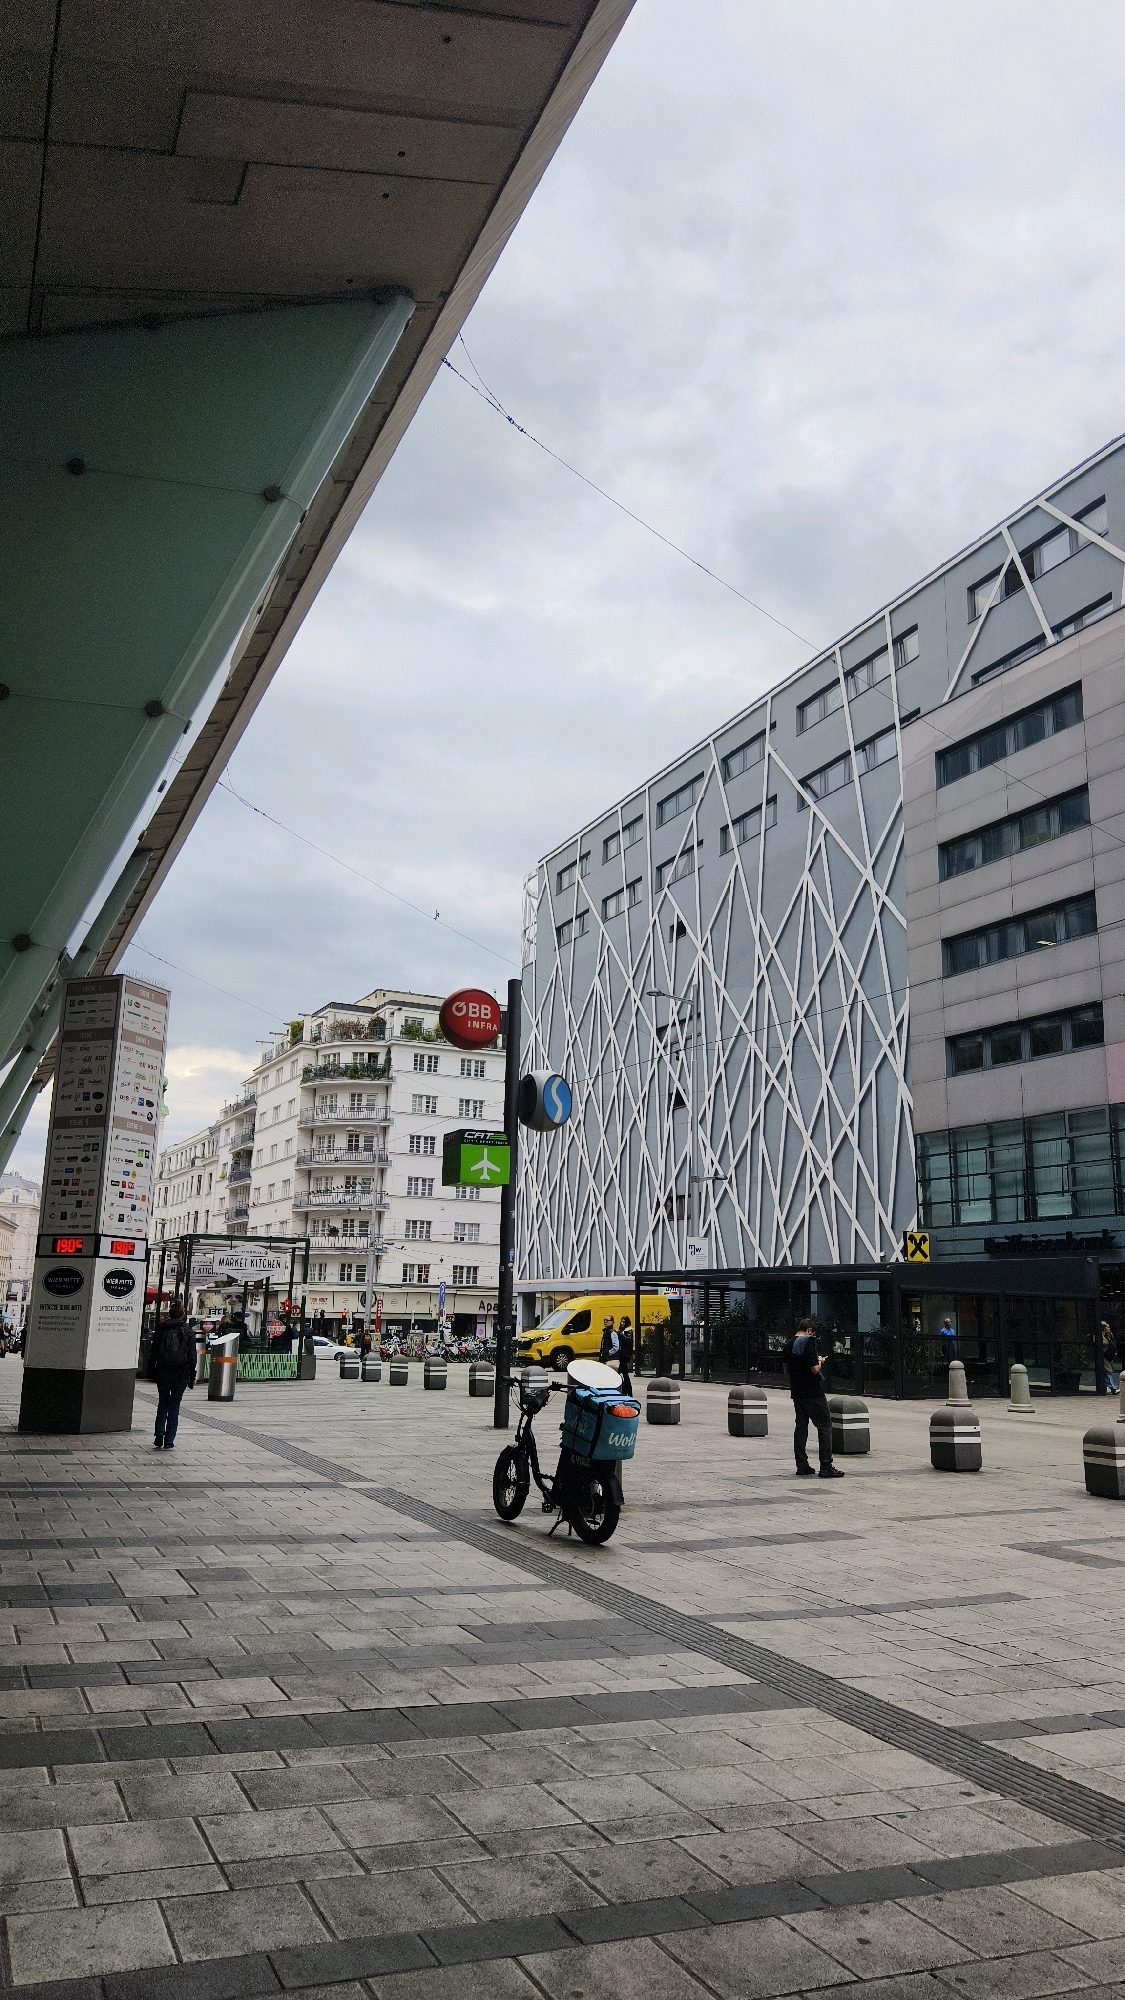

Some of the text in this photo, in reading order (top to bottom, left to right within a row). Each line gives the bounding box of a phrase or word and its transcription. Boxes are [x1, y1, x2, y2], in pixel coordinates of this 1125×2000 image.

[452, 1001, 491, 1019] ÖBB
[467, 1020, 498, 1032] INFRA
[464, 1131, 494, 1140] CAT
[218, 1257, 281, 1269] MARKET KITCHEN
[608, 1432, 637, 1447] Wolt
